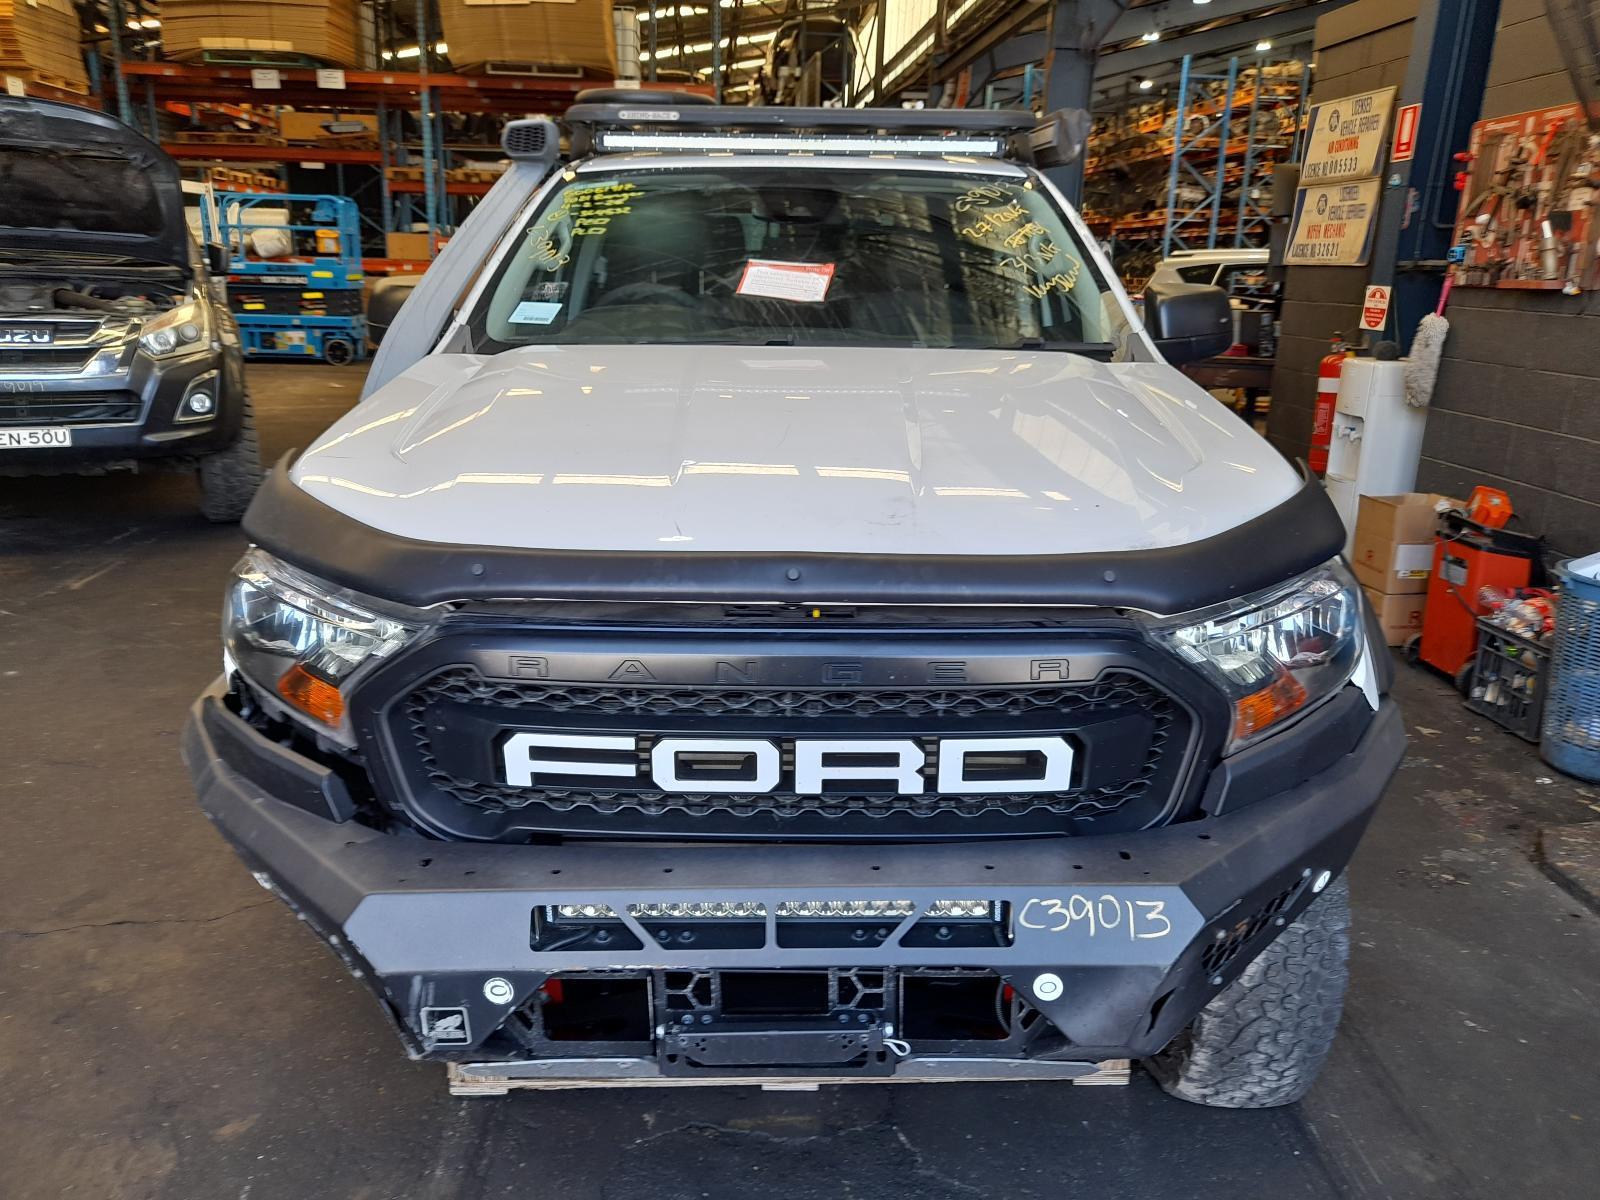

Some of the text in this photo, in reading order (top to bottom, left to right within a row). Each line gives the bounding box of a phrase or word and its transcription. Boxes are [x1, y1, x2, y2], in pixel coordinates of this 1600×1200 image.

[1316, 242, 1339, 256] 32621
[507, 655, 1070, 684] RANGER
[503, 732, 1074, 795] FORD
[1018, 893, 1172, 942] C39013
